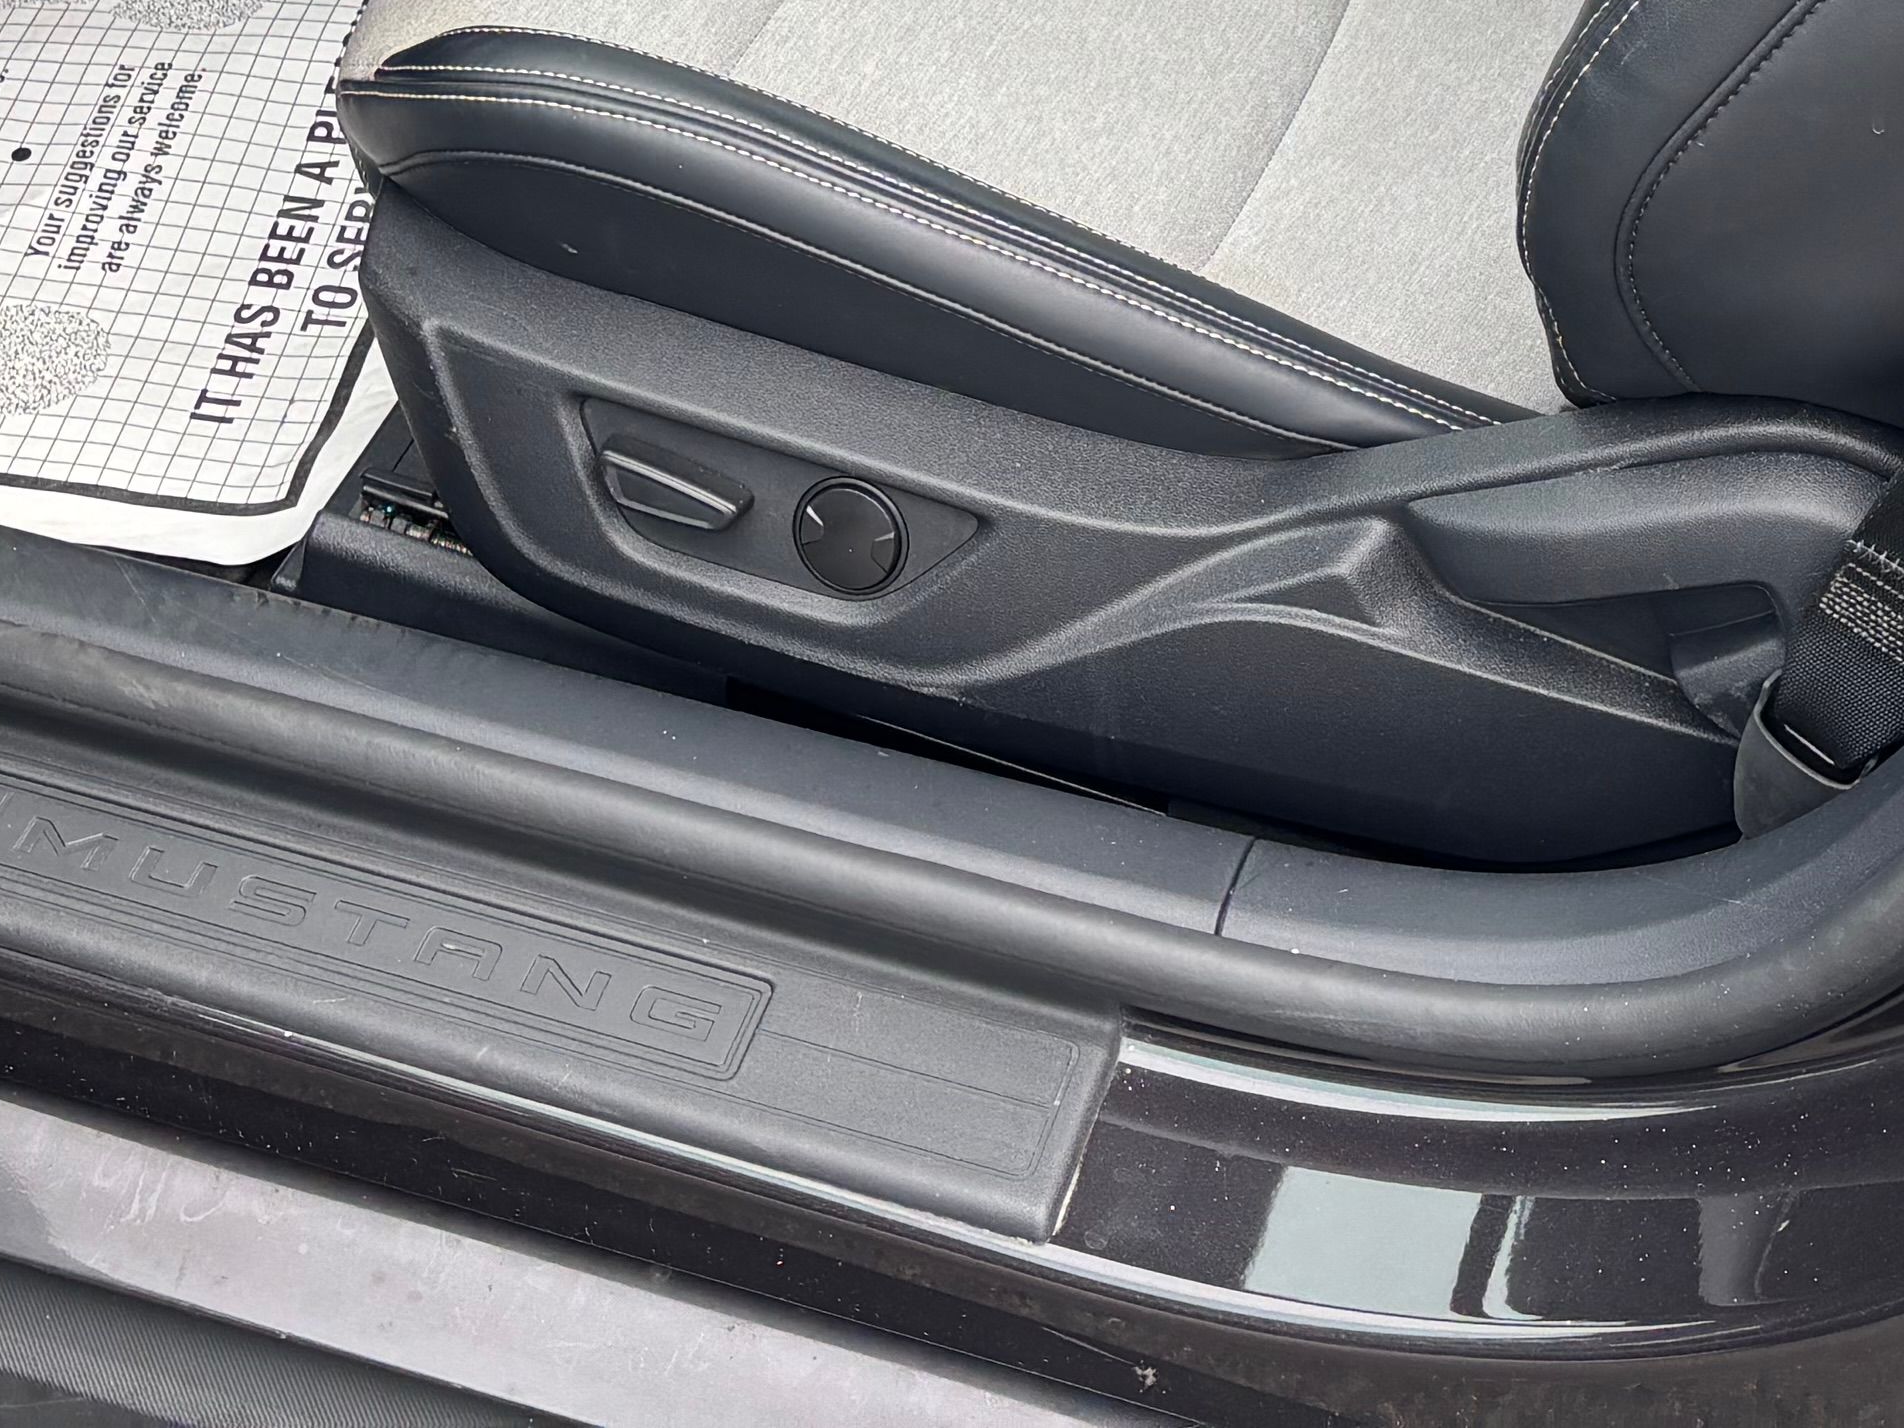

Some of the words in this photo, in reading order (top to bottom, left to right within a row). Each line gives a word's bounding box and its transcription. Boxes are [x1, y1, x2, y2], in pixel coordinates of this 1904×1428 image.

[24, 213, 66, 257] Your
[54, 94, 121, 209] suggestions
[105, 64, 135, 89] for
[57, 168, 128, 271] improving
[111, 130, 139, 164] our
[128, 61, 173, 126] service
[101, 240, 130, 273] are
[118, 163, 163, 235] always
[150, 67, 208, 158] welcome.
[295, 159, 340, 186] A
[248, 194, 325, 291] BEEN
[326, 187, 374, 272] SER
[210, 303, 281, 380] HAS
[300, 284, 359, 332] TO
[190, 388, 243, 425] IT
[14, 814, 725, 1044] MUSTANG
